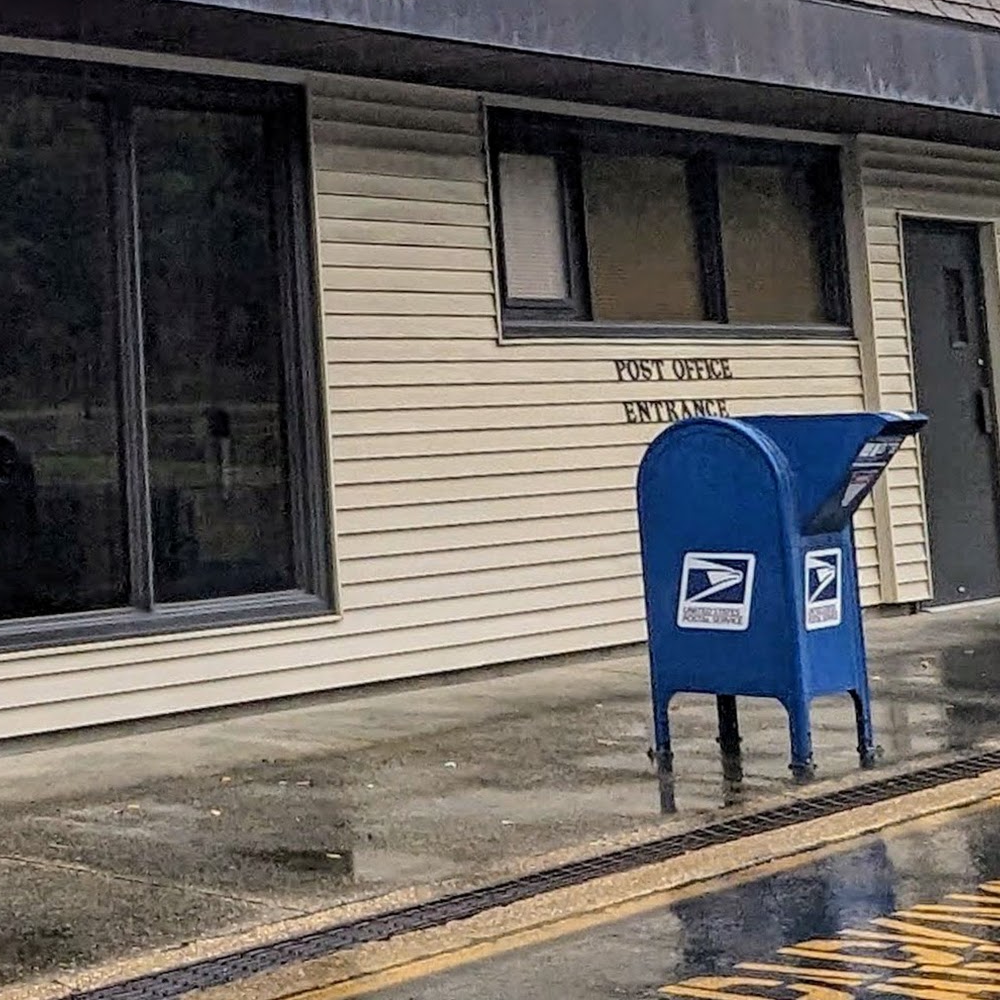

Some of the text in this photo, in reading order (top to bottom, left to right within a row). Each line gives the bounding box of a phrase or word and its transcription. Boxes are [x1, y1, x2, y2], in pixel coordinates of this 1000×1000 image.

[613, 358, 733, 381] POST OFFICE
[622, 400, 730, 423] ENTRANCE
